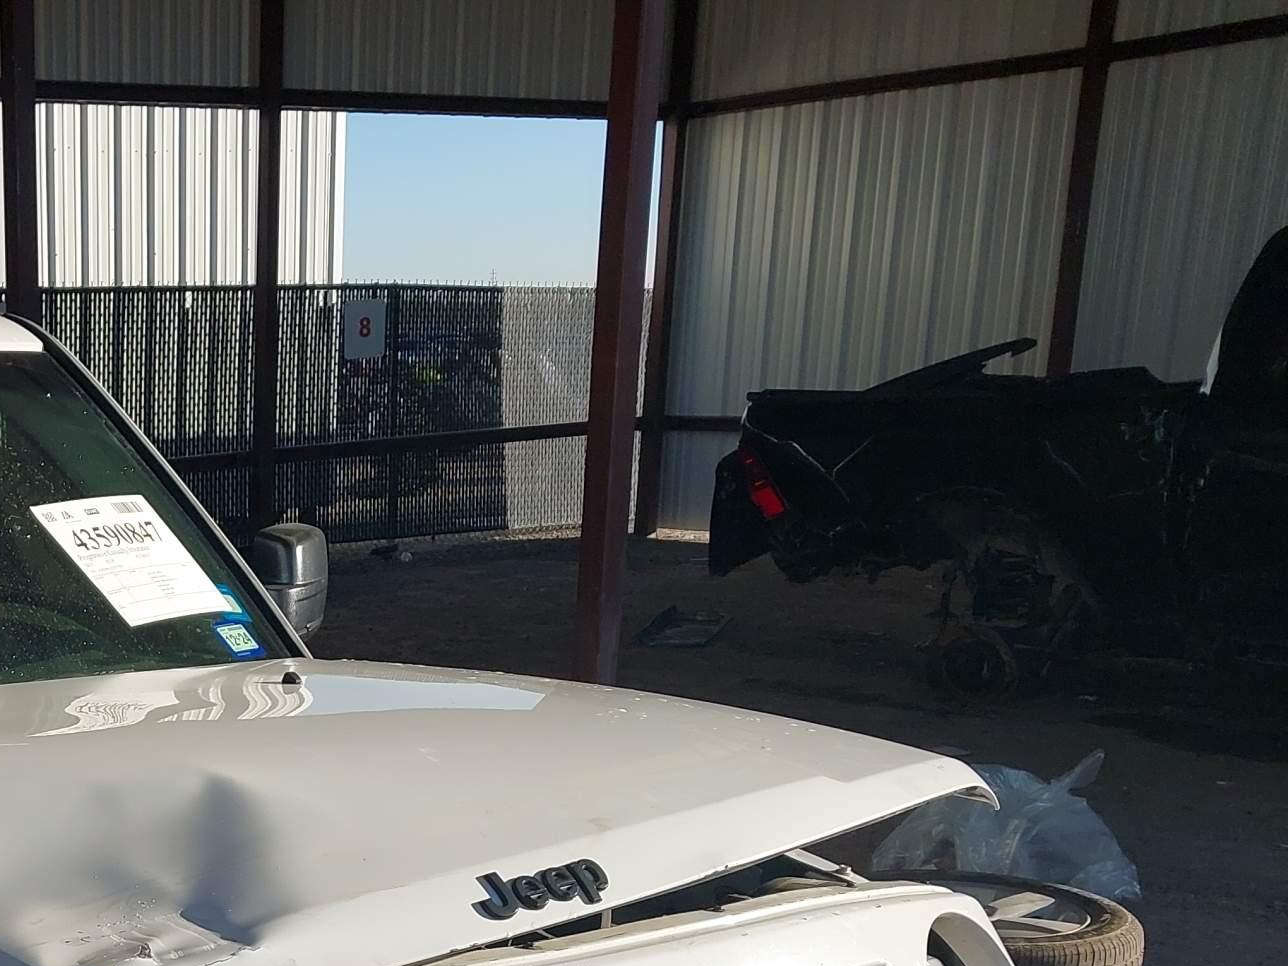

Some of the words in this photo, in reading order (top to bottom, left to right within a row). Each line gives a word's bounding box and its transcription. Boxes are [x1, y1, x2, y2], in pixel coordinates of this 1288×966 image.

[360, 316, 371, 338] 8
[72, 521, 161, 551] 43590847
[471, 858, 609, 921] Jeep
